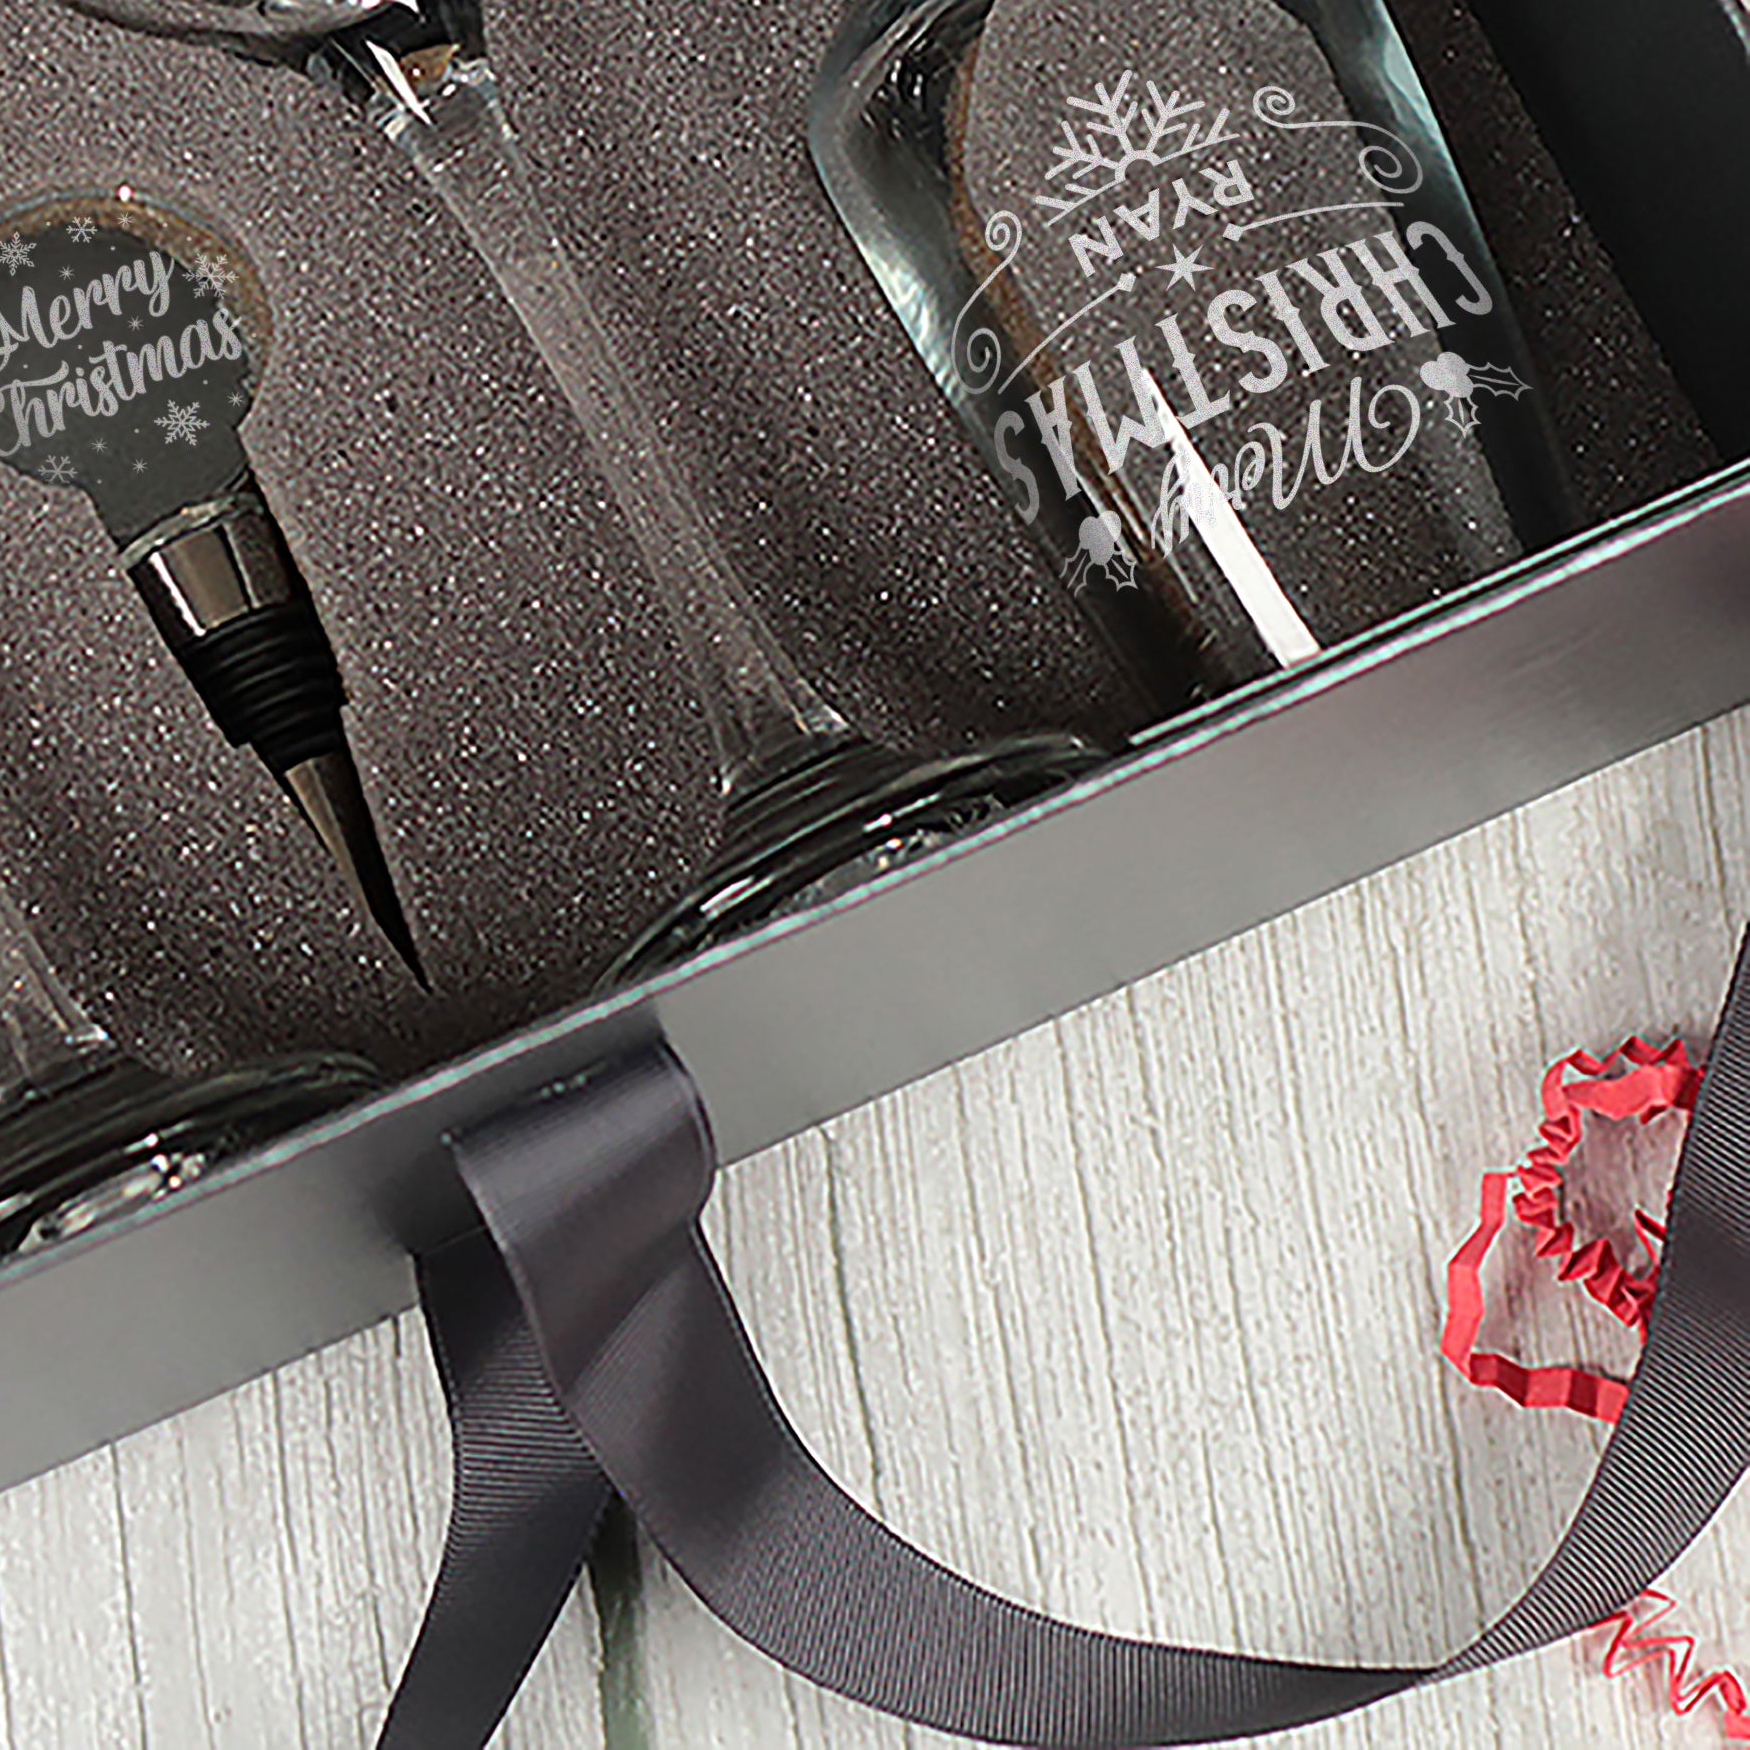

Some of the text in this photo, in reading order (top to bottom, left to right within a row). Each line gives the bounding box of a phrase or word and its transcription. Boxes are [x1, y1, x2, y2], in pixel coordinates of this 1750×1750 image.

[1068, 160, 1255, 278] RYAN
[993, 221, 1493, 525] CHRISTMAS
[1151, 376, 1421, 559] Mery
